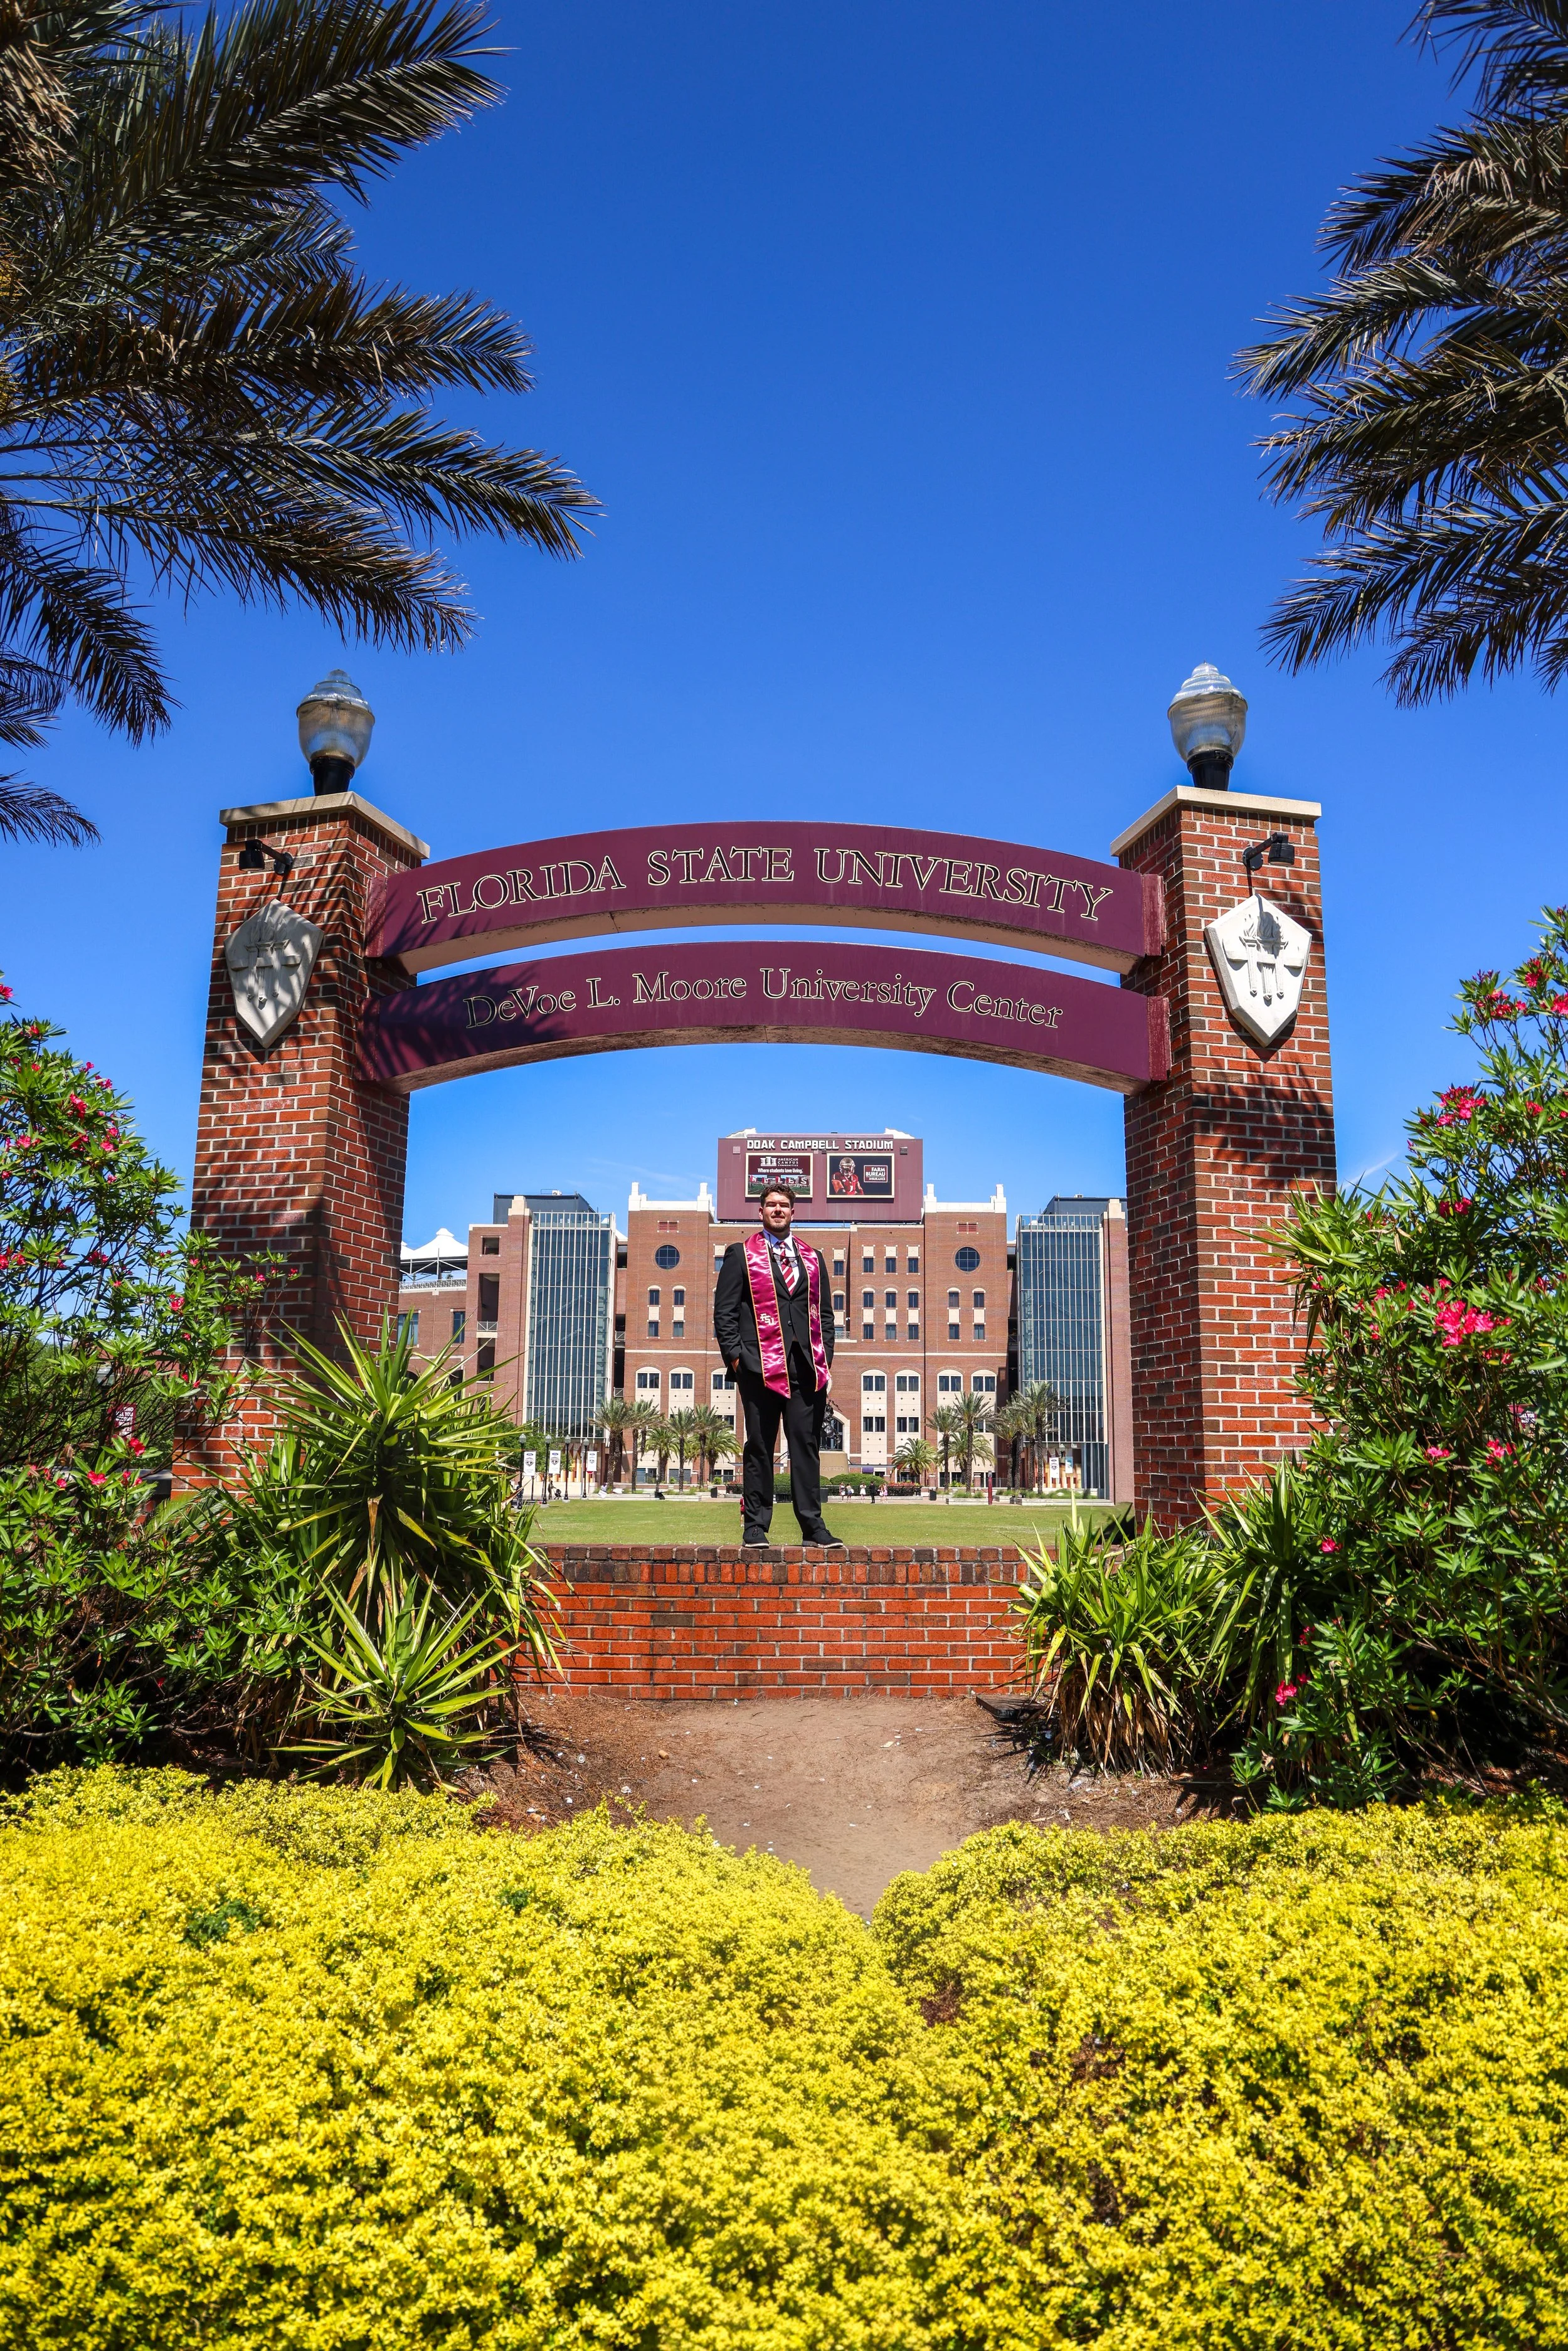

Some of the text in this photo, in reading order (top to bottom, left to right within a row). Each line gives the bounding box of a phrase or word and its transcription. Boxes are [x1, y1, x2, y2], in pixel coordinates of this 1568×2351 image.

[416, 846, 1113, 924] FLORIDA STATE UNIVERSITY
[463, 968, 1063, 1029] DeVoe L. Moore University Center
[747, 1140, 893, 1149] DOAK CAMPBELL STADIUM
[760, 1313, 775, 1325] FSU
